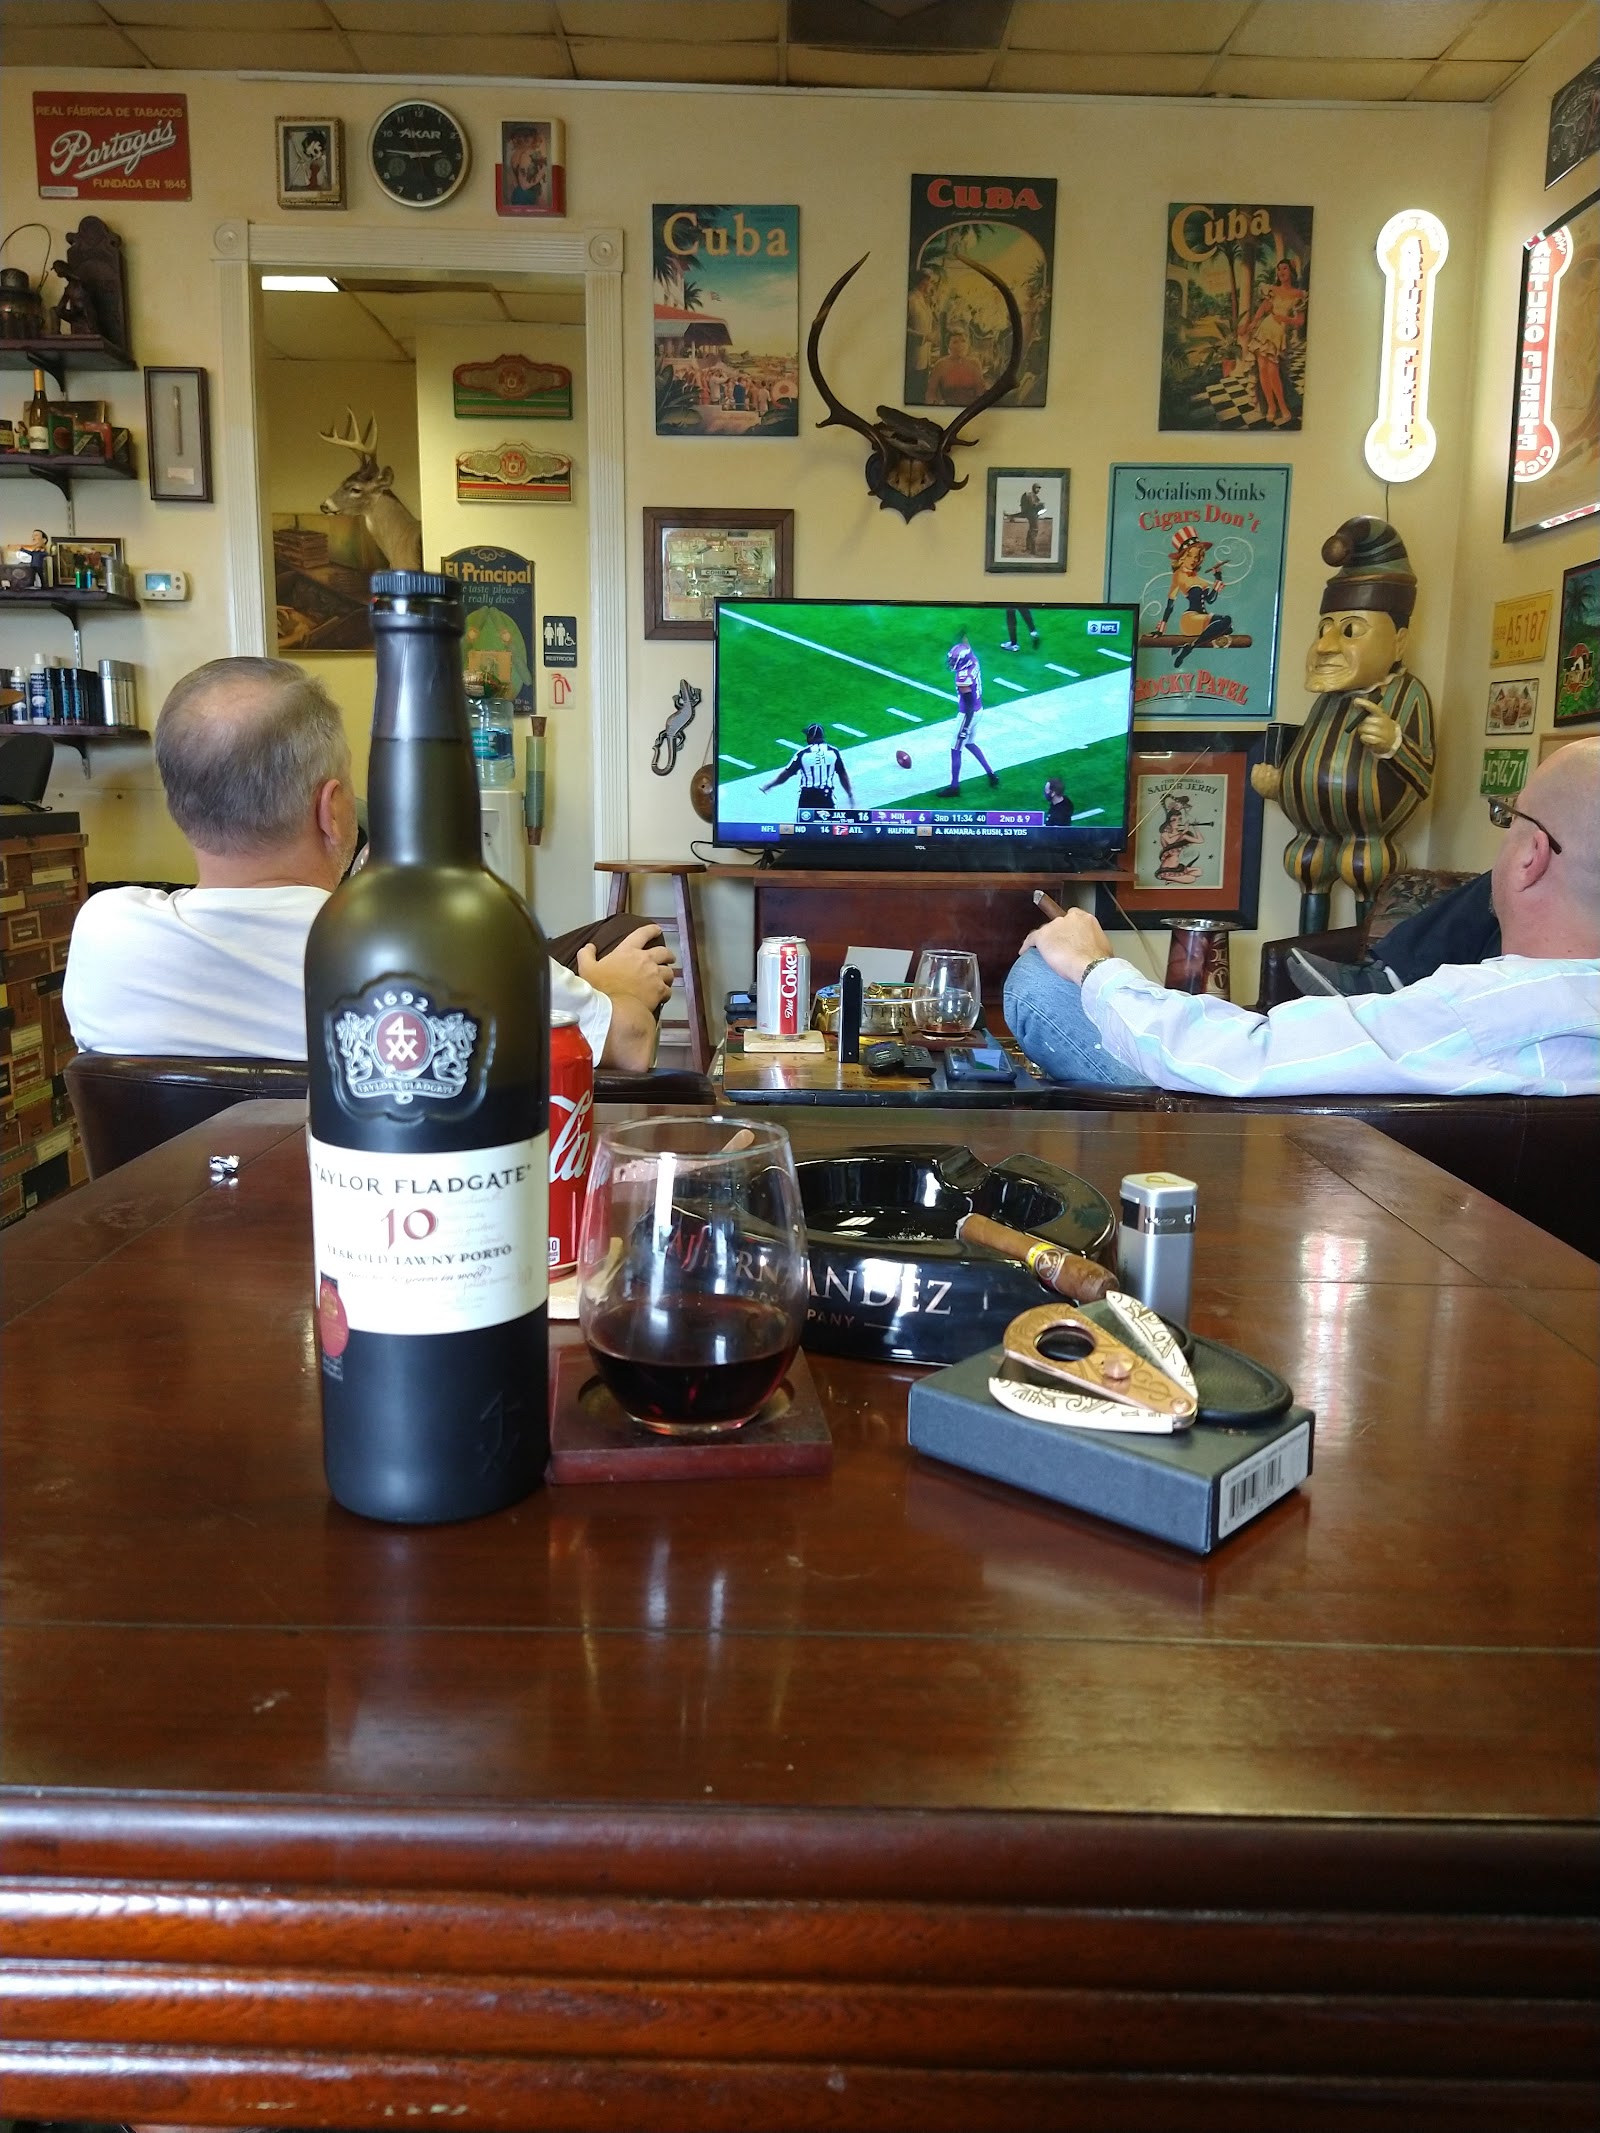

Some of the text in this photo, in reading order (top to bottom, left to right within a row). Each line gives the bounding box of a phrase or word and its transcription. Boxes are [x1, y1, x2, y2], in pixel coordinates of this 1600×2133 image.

[36, 105, 183, 118] REAL FÁBRICA DE TABACOS
[50, 119, 176, 178] Partagás
[93, 179, 187, 190] FUNDADA EN 1845
[927, 178, 1043, 211] CUBA
[663, 211, 789, 257] Cuba
[1171, 204, 1272, 262] Cuba
[1135, 476, 1265, 501] Socialism Stinks
[1138, 503, 1261, 533] Cigars Don't
[462, 562, 532, 586] Principal
[469, 586, 489, 594] taste
[468, 594, 493, 604] really
[1101, 624, 1117, 632] NFL
[1195, 669, 1249, 705] PATEL
[1147, 782, 1218, 795] SAILOR JERRY
[858, 812, 869, 821] 16
[918, 813, 925, 822] 6
[934, 814, 949, 822] 3RD
[952, 814, 973, 822] 11:34
[1000, 815, 1031, 823] 2ND & 9
[761, 825, 776, 833] NFL
[976, 828, 981, 836] 6
[781, 954, 798, 1019] Diet Coke
[373, 990, 429, 1012] 1692
[357, 1080, 453, 1094] TAYLOR FLADGATE
[380, 1208, 437, 1250] 10
[395, 1254, 455, 1266] TAWNY
[460, 1244, 512, 1263] PORTO
